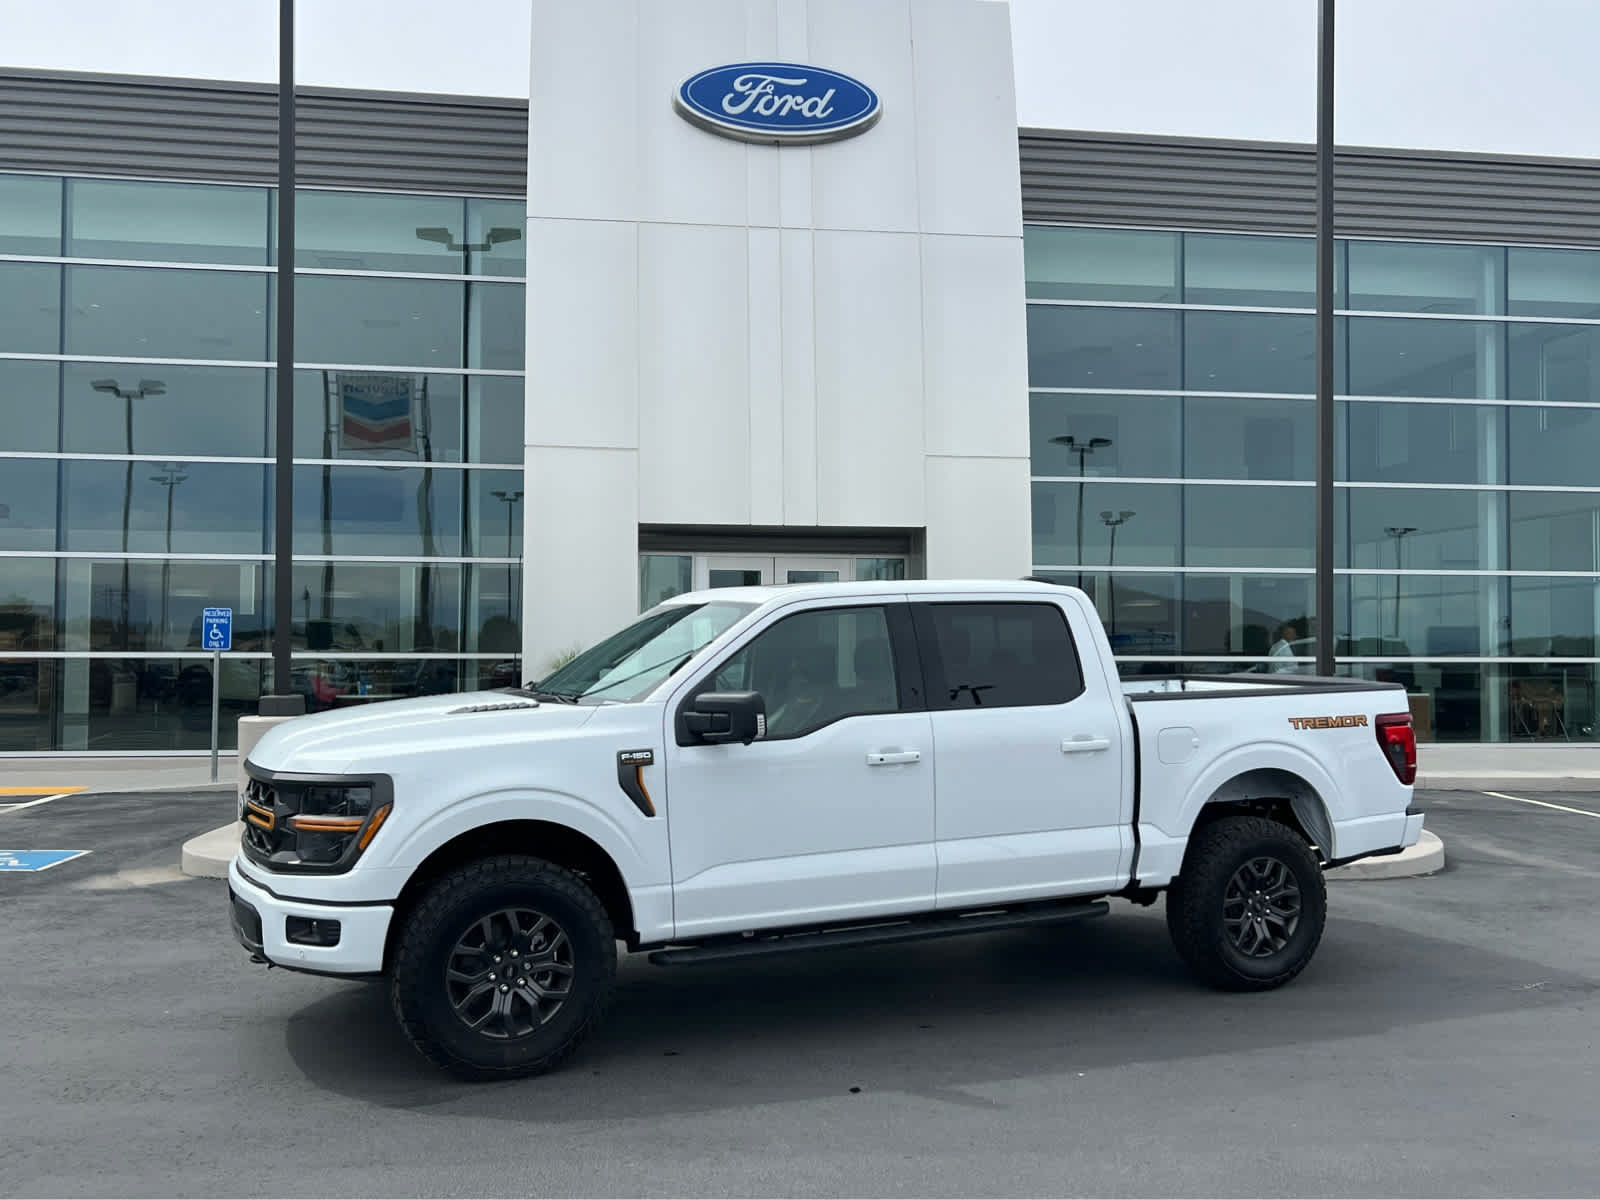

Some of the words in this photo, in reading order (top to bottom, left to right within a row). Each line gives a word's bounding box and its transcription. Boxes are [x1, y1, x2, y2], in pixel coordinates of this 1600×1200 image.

[722, 74, 836, 118] Ford
[1288, 715, 1368, 730] TREMOR
[621, 751, 651, 760] F-150
